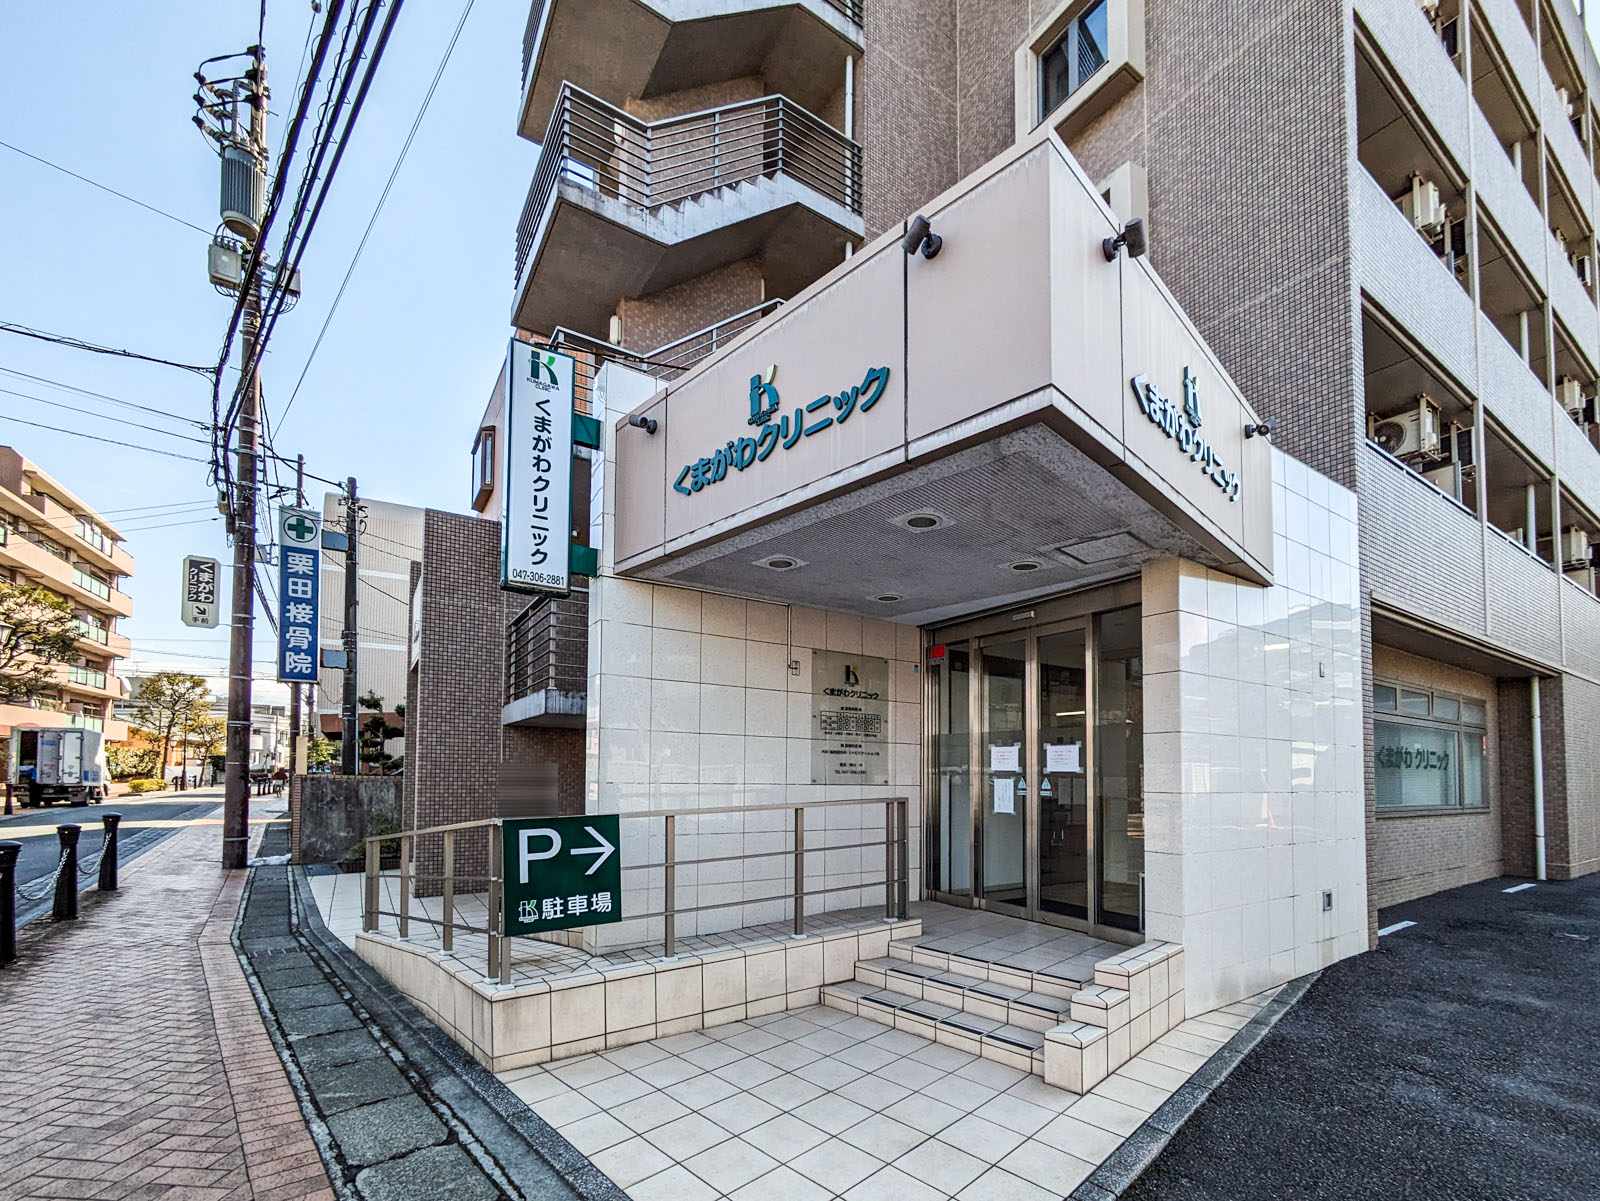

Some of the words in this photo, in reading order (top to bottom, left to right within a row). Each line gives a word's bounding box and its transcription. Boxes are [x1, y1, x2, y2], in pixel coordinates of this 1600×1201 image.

[526, 376, 560, 391] KUMAGAWA
[535, 384, 551, 393] CLINIC
[672, 366, 890, 496] くまがわクリニック
[1131, 372, 1241, 502] くまがわクリニック
[530, 398, 552, 566] くまがわクリニック
[188, 567, 198, 601] クリニック
[198, 563, 214, 604] くまがわ
[512, 568, 565, 586] 047-306-2881
[191, 616, 209, 625] 手前
[285, 551, 314, 674] 栗田接骨院
[823, 687, 879, 700] くまがわクリニック
[1377, 745, 1449, 771] くまがわクリニック
[518, 827, 562, 884] P
[541, 892, 612, 920] 駐車場
